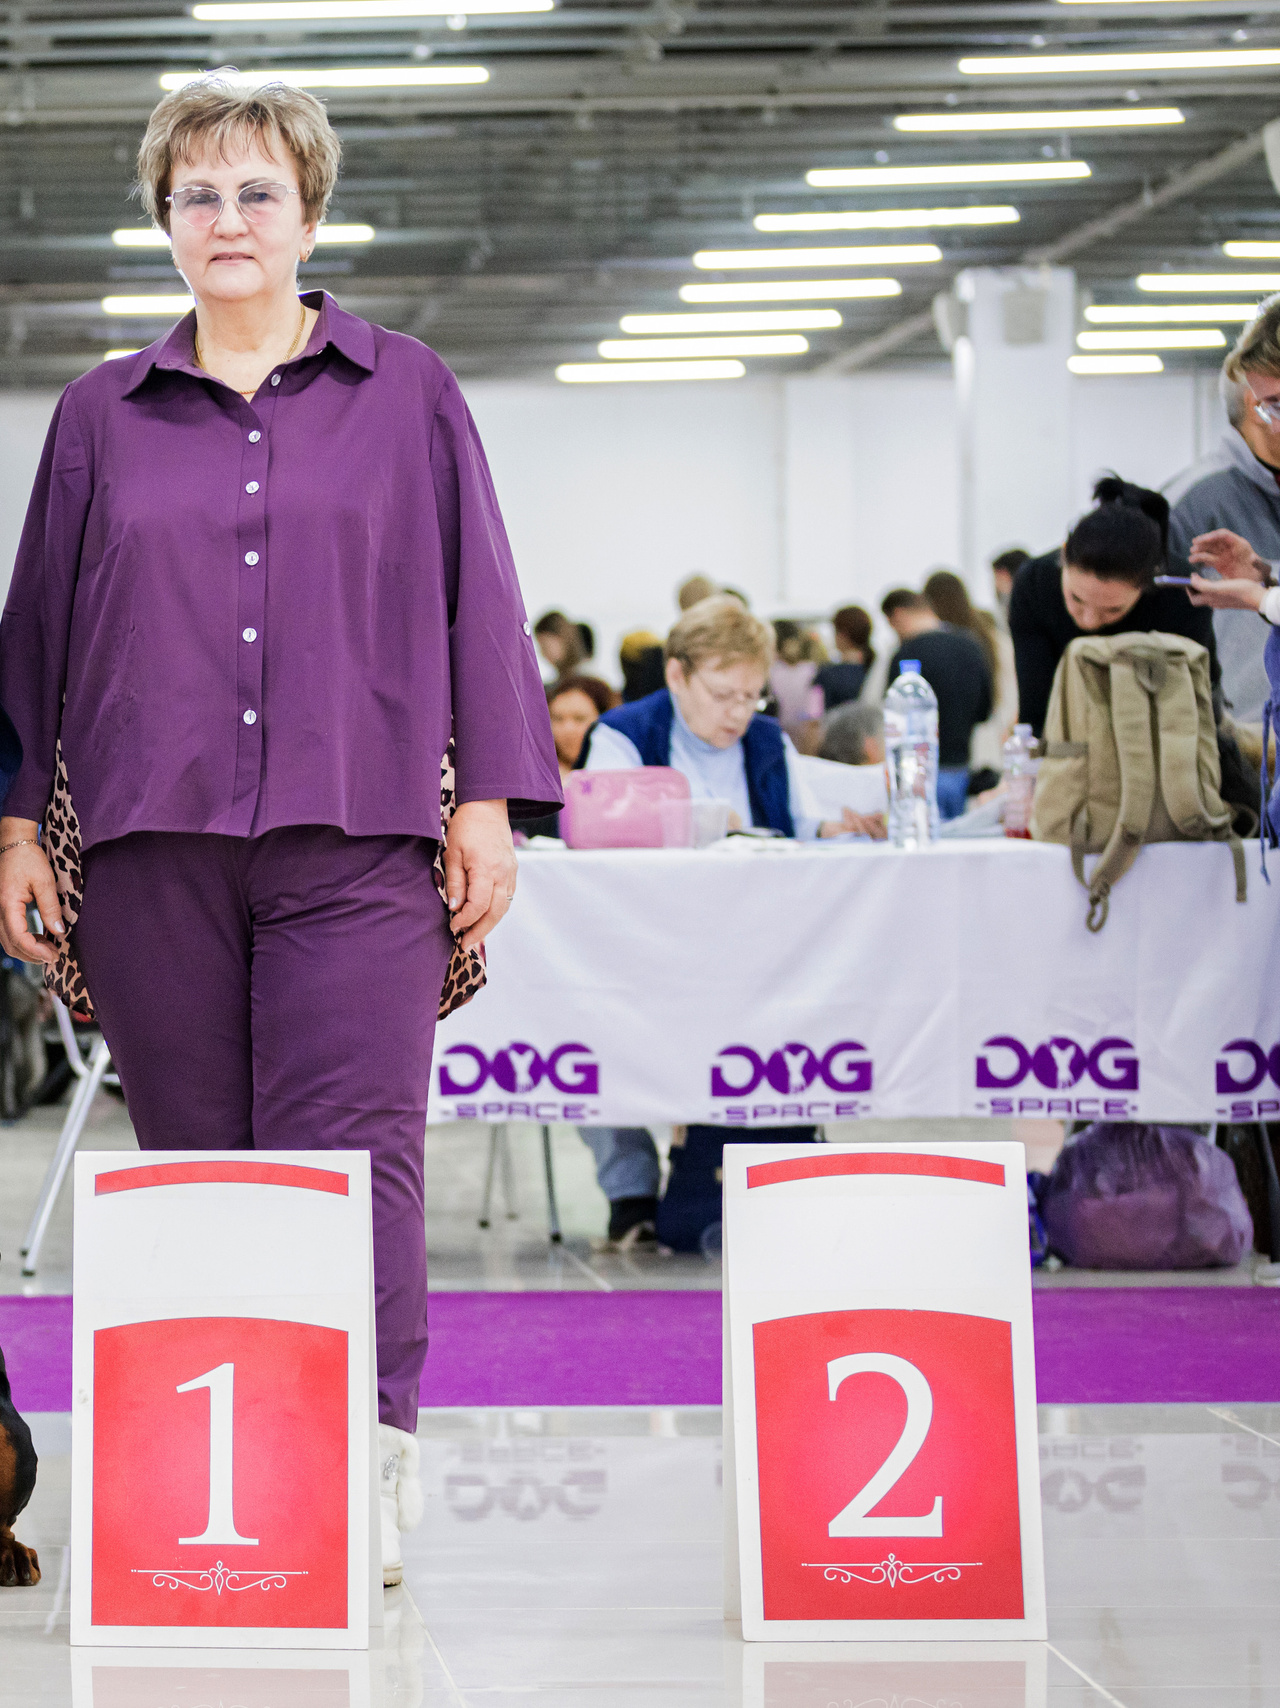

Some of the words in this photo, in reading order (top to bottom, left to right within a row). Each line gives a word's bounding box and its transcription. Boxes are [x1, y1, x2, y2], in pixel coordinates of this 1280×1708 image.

[439, 1042, 599, 1095] DOG
[711, 1040, 872, 1097] DOG
[976, 1035, 1139, 1090] DOG
[1216, 1038, 1280, 1094] D
[176, 1362, 259, 1545] 1
[827, 1352, 943, 1537] 2
